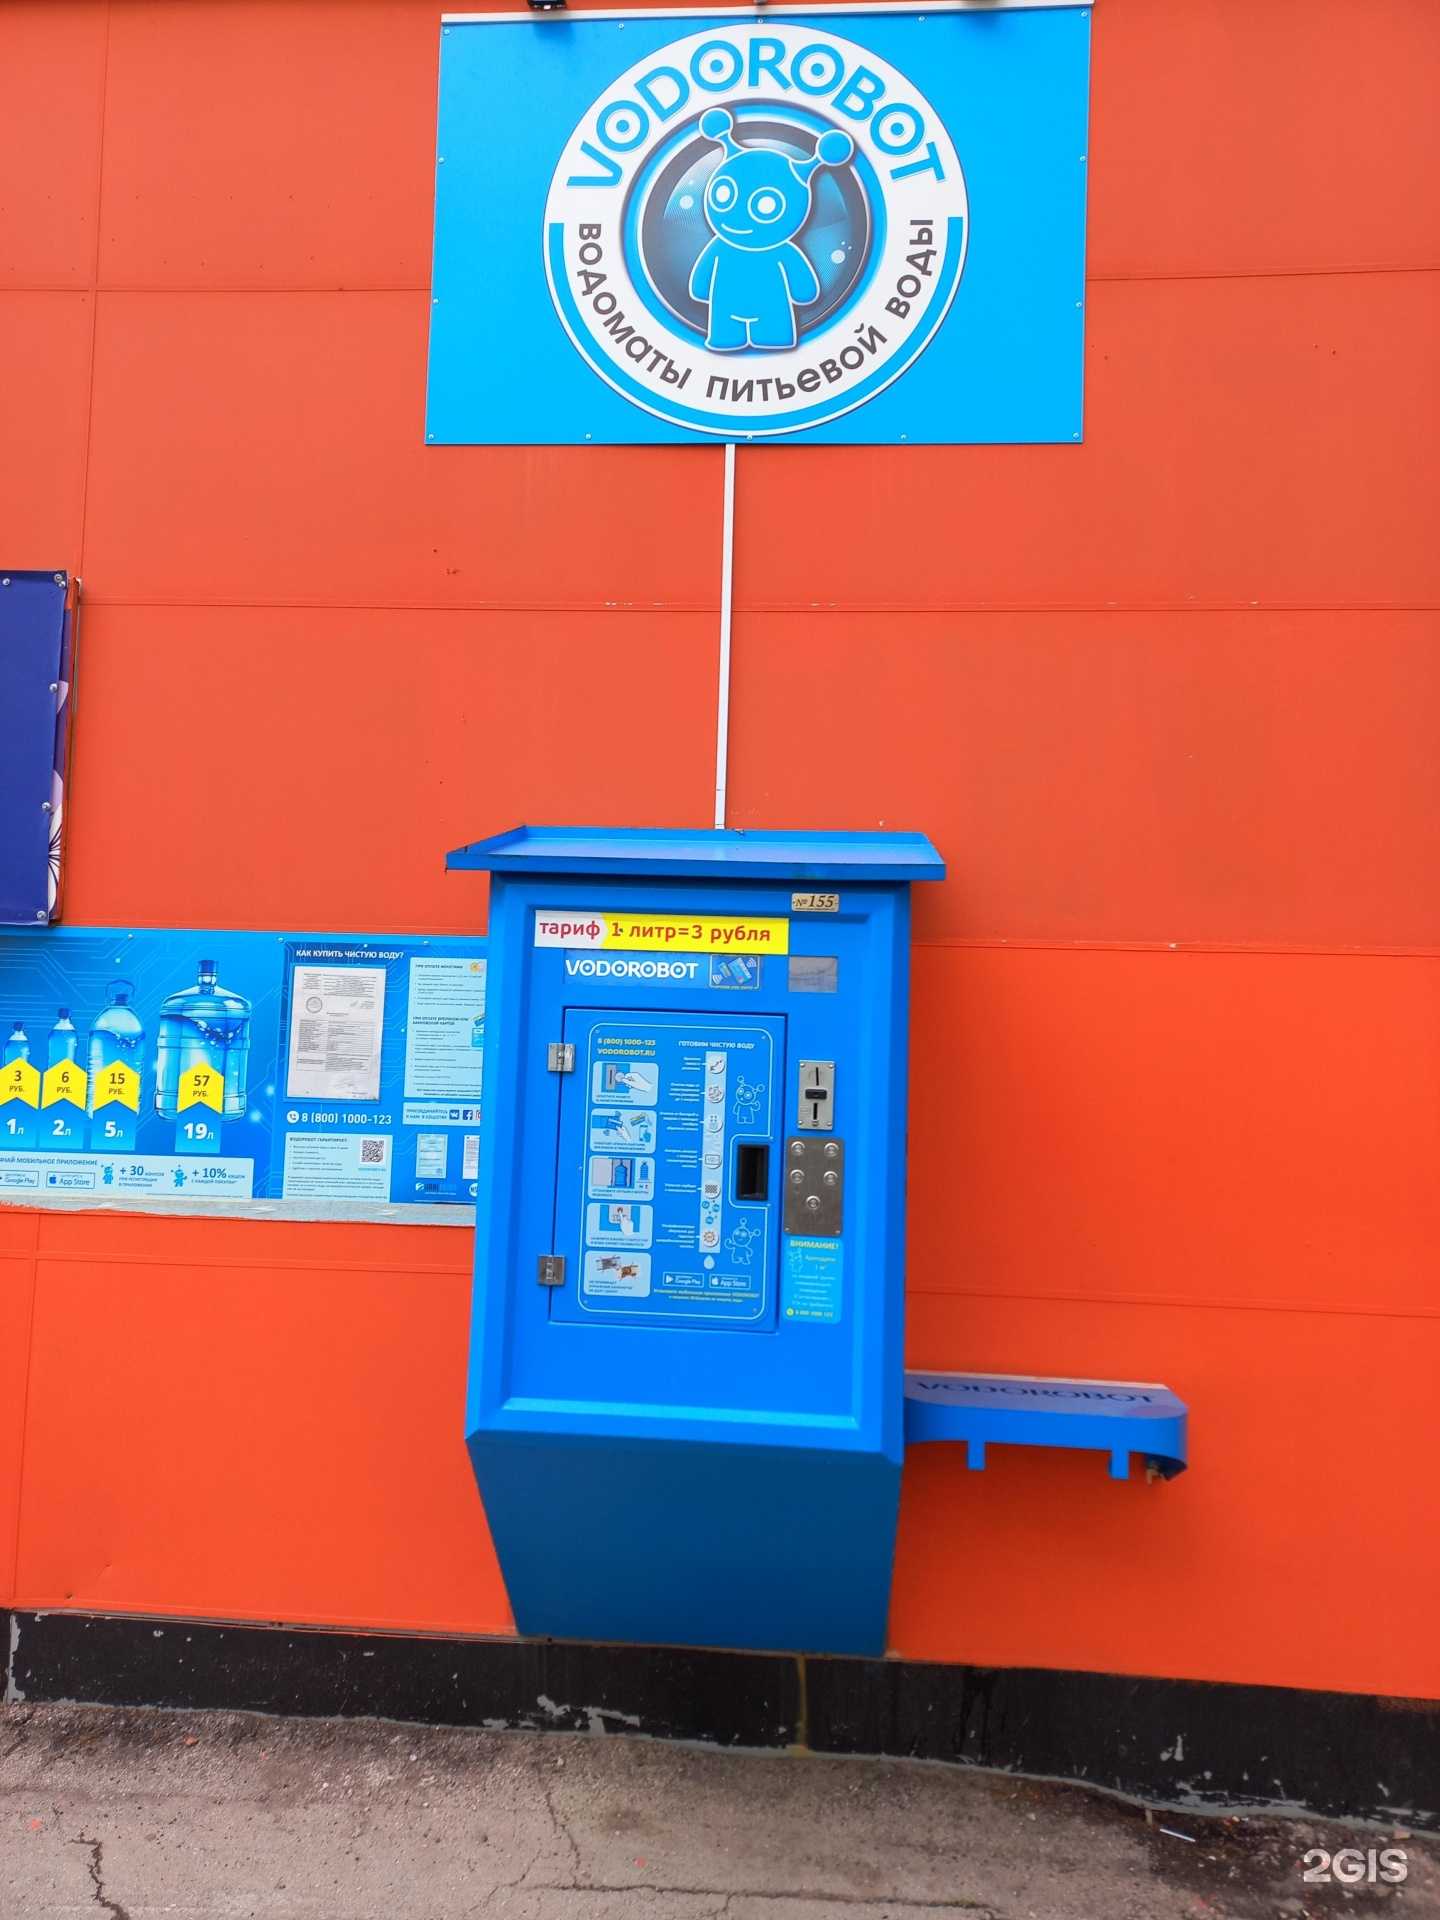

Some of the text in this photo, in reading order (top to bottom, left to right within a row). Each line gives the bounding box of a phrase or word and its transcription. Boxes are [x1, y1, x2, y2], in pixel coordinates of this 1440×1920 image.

[565, 37, 946, 189] VODOROBOT
[540, 920, 600, 939] тариф
[710, 926, 771, 945] рубля
[296, 949, 404, 960] КАК КУПИТЬ ЧИСТУЮ ВОДУ?
[565, 959, 699, 979] VODOROBOT
[14, 1070, 22, 1082] 3
[61, 1072, 70, 1083] 6
[110, 1073, 125, 1084] 15
[194, 1075, 210, 1087] 57
[301, 1112, 309, 1122] 8
[311, 1112, 338, 1124] (800)
[342, 1113, 392, 1125] 1000-123
[130, 1165, 144, 1176] 30
[202, 1167, 227, 1178] 10%
